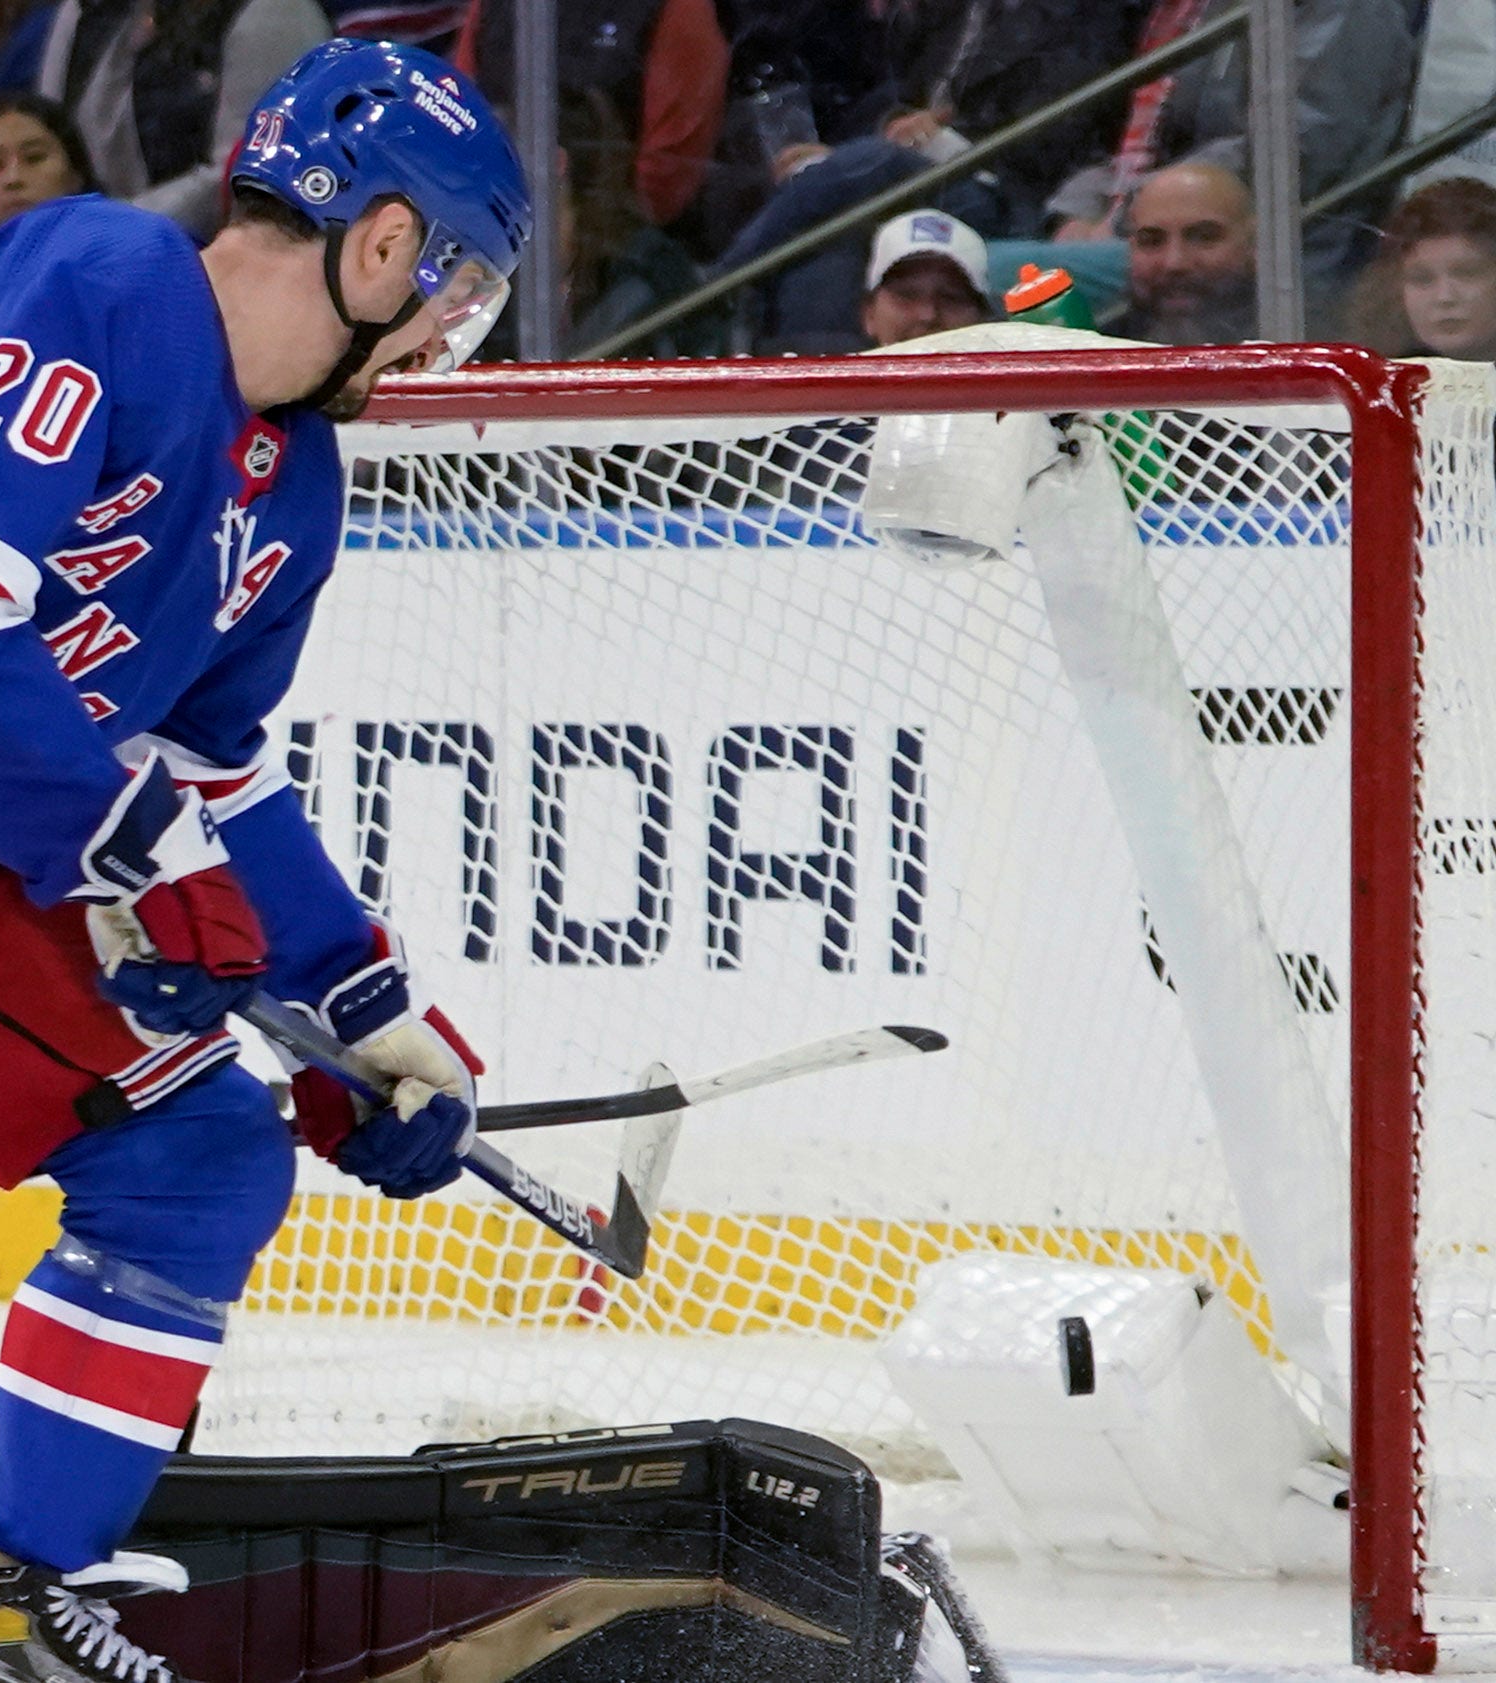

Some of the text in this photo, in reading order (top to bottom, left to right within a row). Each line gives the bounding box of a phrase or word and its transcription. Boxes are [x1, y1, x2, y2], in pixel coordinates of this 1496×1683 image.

[409, 69, 478, 131] Benjamin
[414, 91, 465, 136] Moore
[246, 110, 284, 153] 20
[213, 540, 293, 633] A
[287, 722, 928, 975] NDAI
[462, 1461, 686, 1504] TRUE
[747, 1470, 822, 1509] L12.2
